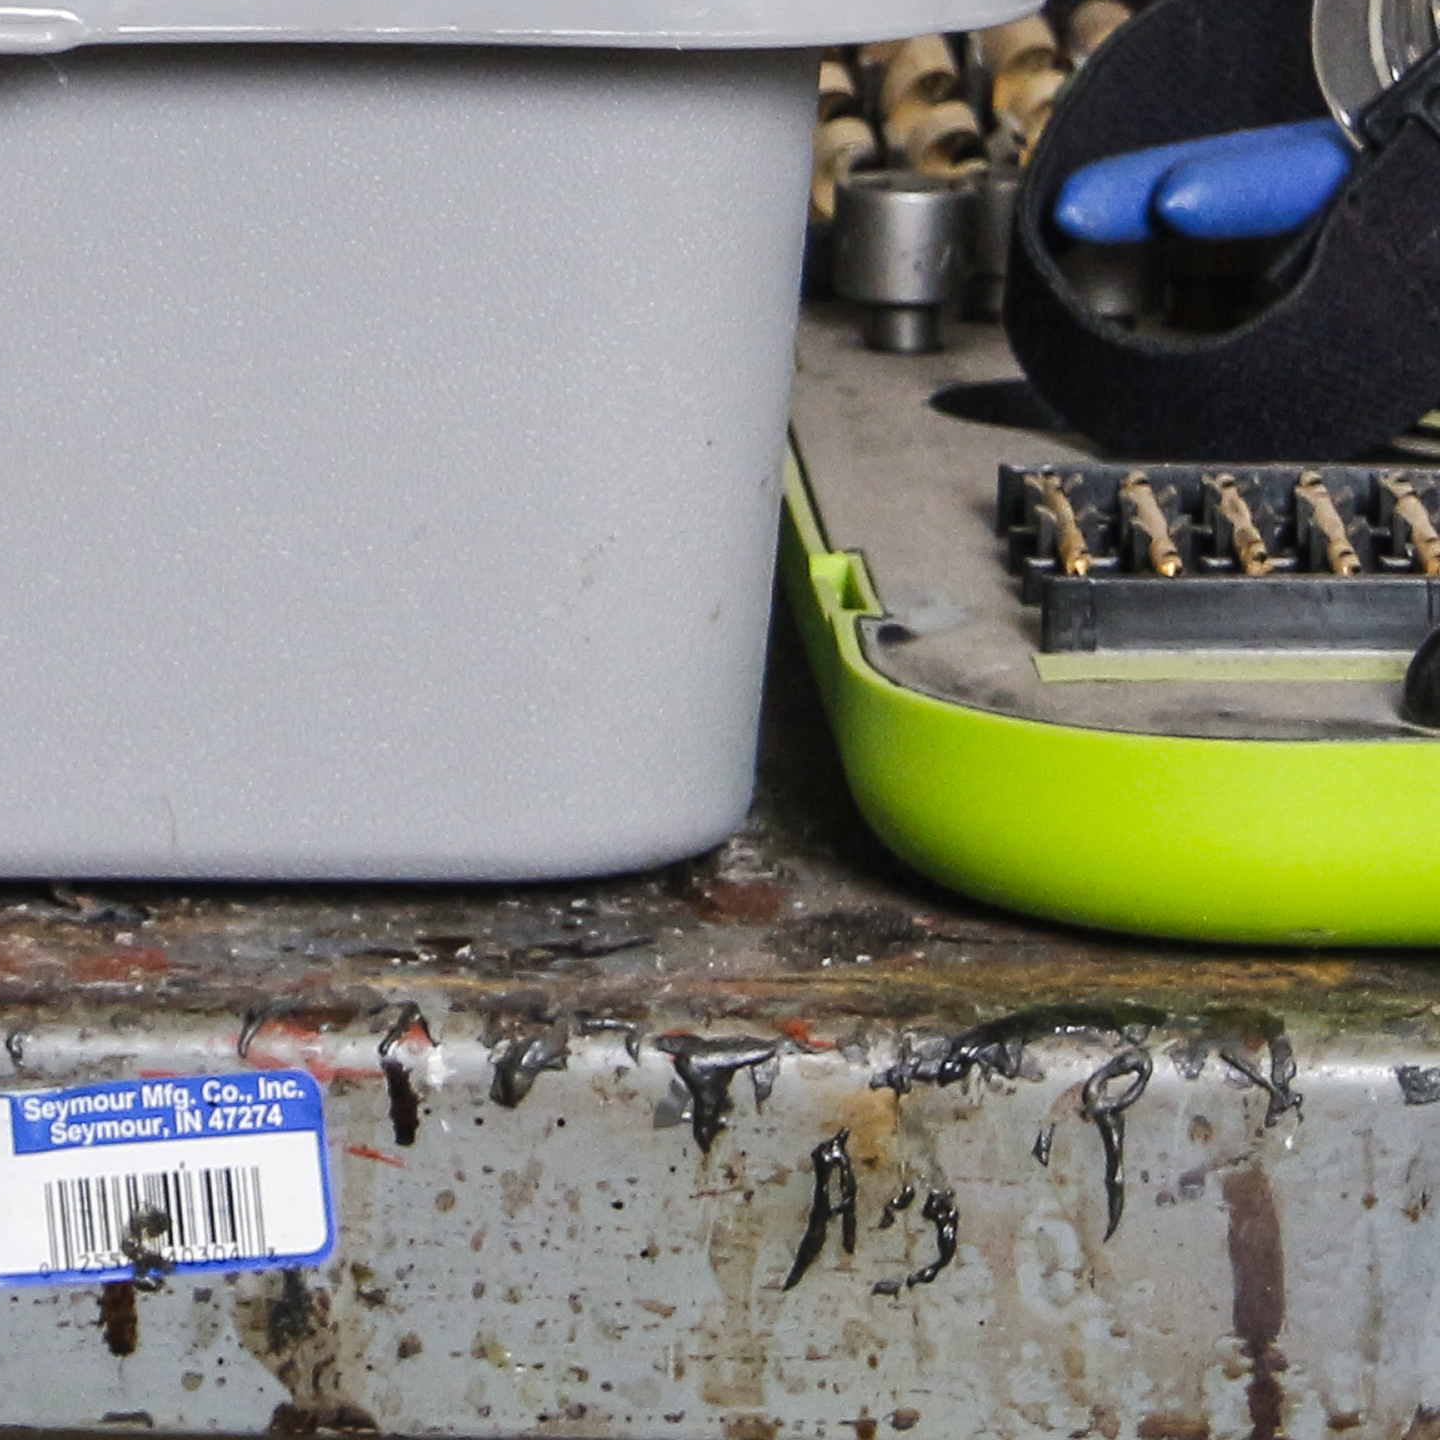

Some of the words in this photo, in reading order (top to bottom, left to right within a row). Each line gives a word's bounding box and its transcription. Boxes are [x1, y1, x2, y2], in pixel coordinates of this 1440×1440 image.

[23, 1090, 138, 1123] Seymour
[141, 1083, 196, 1110] Mfg.
[201, 1079, 253, 1103] Co.,
[258, 1076, 304, 1099] Inc.
[50, 1117, 170, 1148] Seymour,
[176, 1109, 203, 1133] IN
[207, 1104, 284, 1132] 47274
